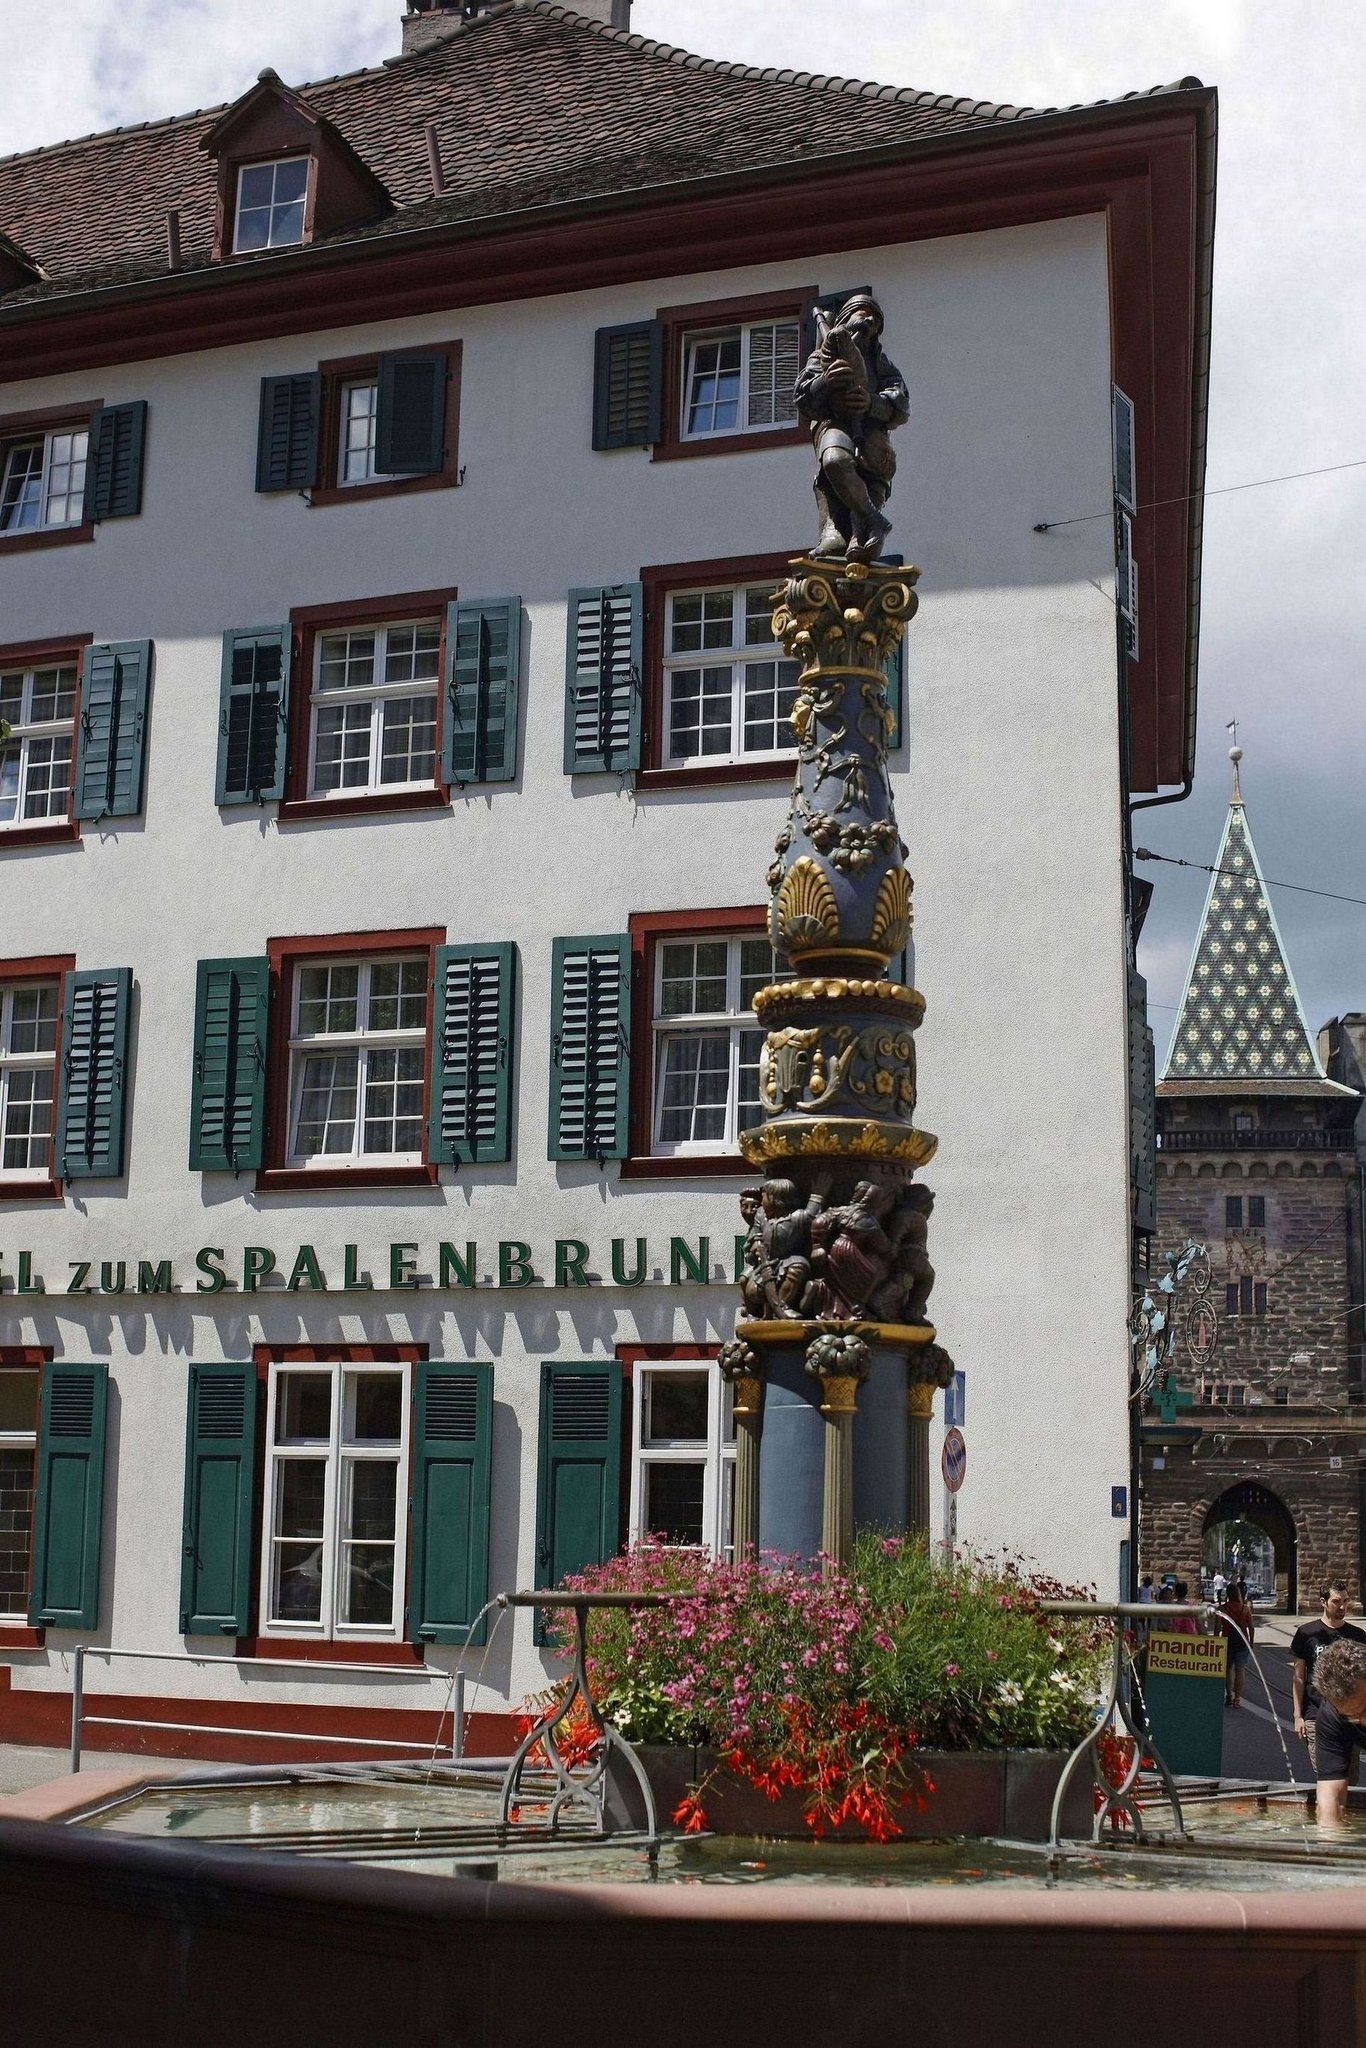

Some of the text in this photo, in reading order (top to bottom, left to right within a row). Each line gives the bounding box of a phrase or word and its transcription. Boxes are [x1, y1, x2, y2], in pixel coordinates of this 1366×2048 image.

[0, 1250, 45, 1294] L
[67, 1261, 172, 1294] ZUM
[1150, 1639, 1224, 1657] mandir
[1149, 1655, 1223, 1672] Restaurant
